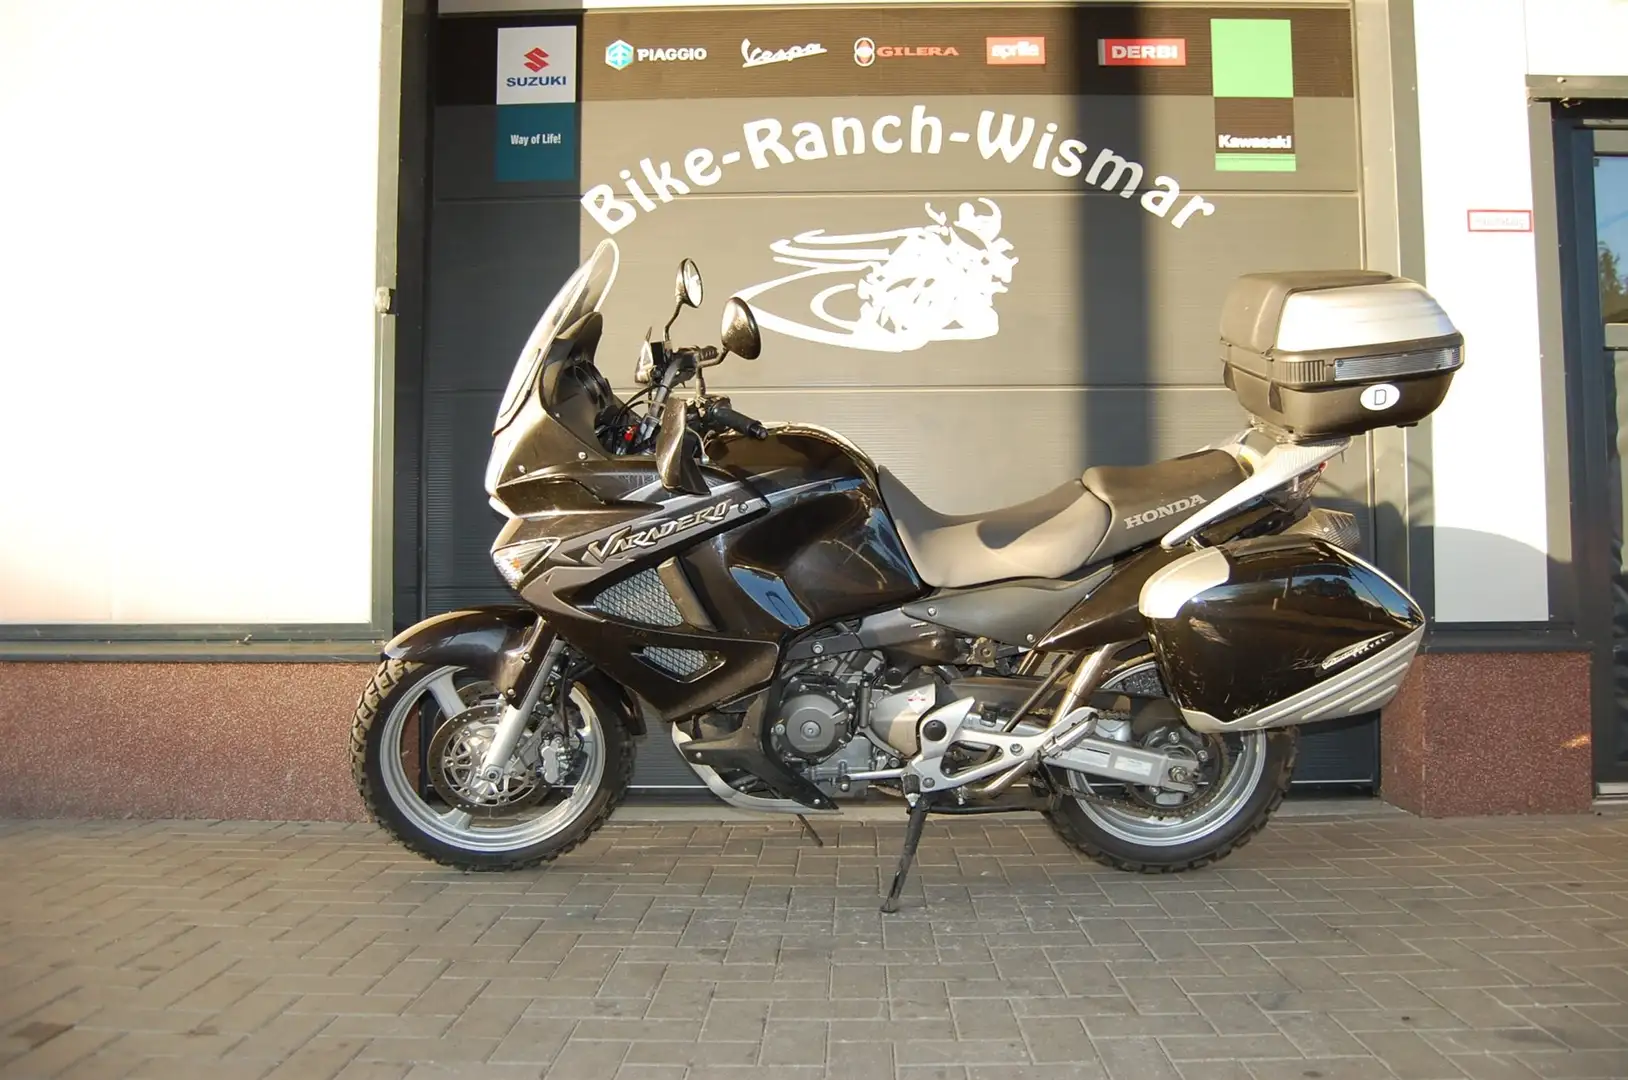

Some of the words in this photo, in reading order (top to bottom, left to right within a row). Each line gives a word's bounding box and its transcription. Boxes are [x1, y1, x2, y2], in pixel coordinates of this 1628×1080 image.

[637, 48, 707, 61] PIAGGIO
[741, 38, 827, 68] Vespa
[876, 46, 959, 57] GILERA
[1111, 45, 1178, 59] DERBI
[506, 76, 567, 87] SUZUKI
[510, 134, 529, 146] Way
[531, 134, 541, 144] of
[542, 133, 562, 144] Life!
[1218, 134, 1292, 148] Kawasaki
[580, 105, 1215, 235] Bike-Ranch-Wismar
[1374, 389, 1387, 405] D
[1124, 494, 1207, 530] HONDA
